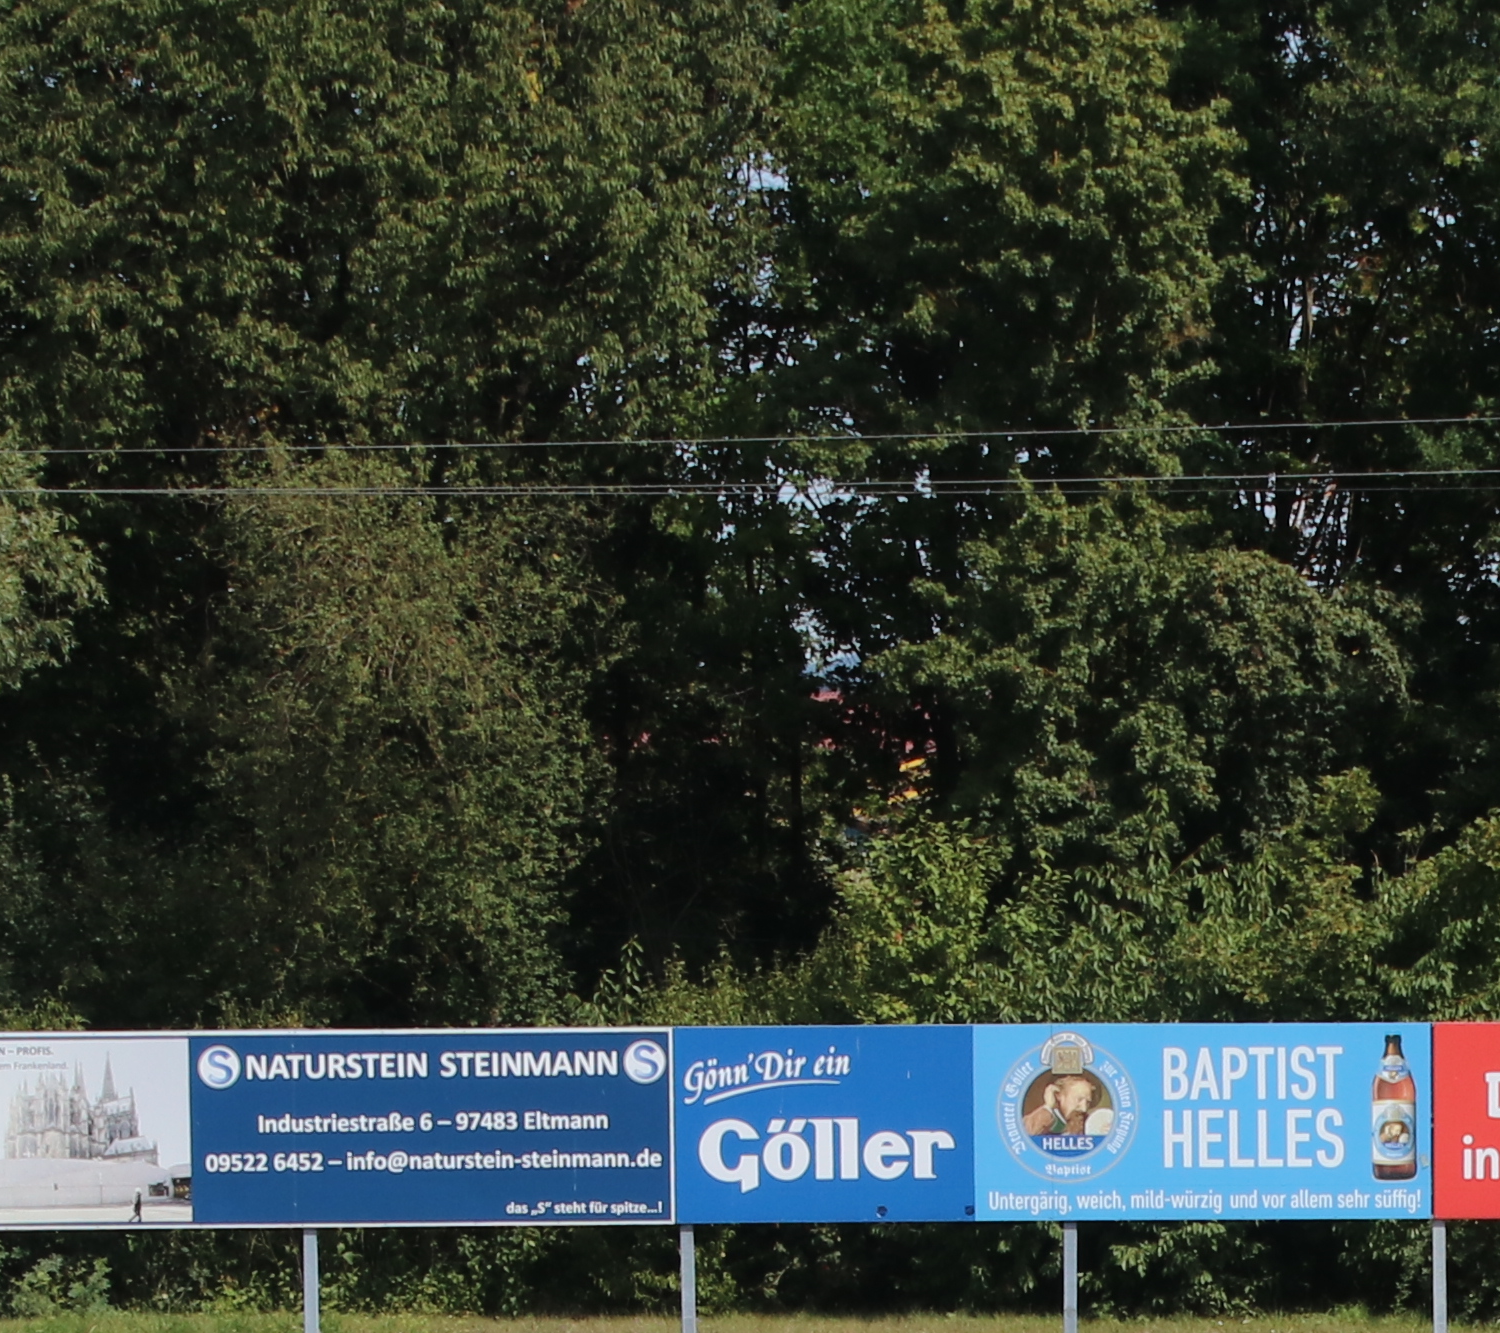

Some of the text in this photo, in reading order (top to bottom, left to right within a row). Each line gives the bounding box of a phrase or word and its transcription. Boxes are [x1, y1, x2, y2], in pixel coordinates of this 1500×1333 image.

[246, 1050, 617, 1079] NATURSTEIN STEINMANN
[813, 1046, 850, 1076] ein
[1163, 1046, 1343, 1100] BAPTIST
[258, 1111, 609, 1134] Industriestraße 6 97483 Eltmann
[1043, 1137, 1093, 1150] HELLES
[1164, 1108, 1345, 1168] HELLES
[205, 1149, 663, 1173] 09522 6452 info@naturstein-steinmann.de
[699, 1118, 956, 1194] Göller
[1462, 1135, 1500, 1180] in
[506, 1202, 528, 1215] das
[554, 1202, 586, 1214] steht
[589, 1201, 607, 1214] für
[988, 1190, 1421, 1215] Untergärig, weich, mild-würzig und vor allem sehr süffig!
